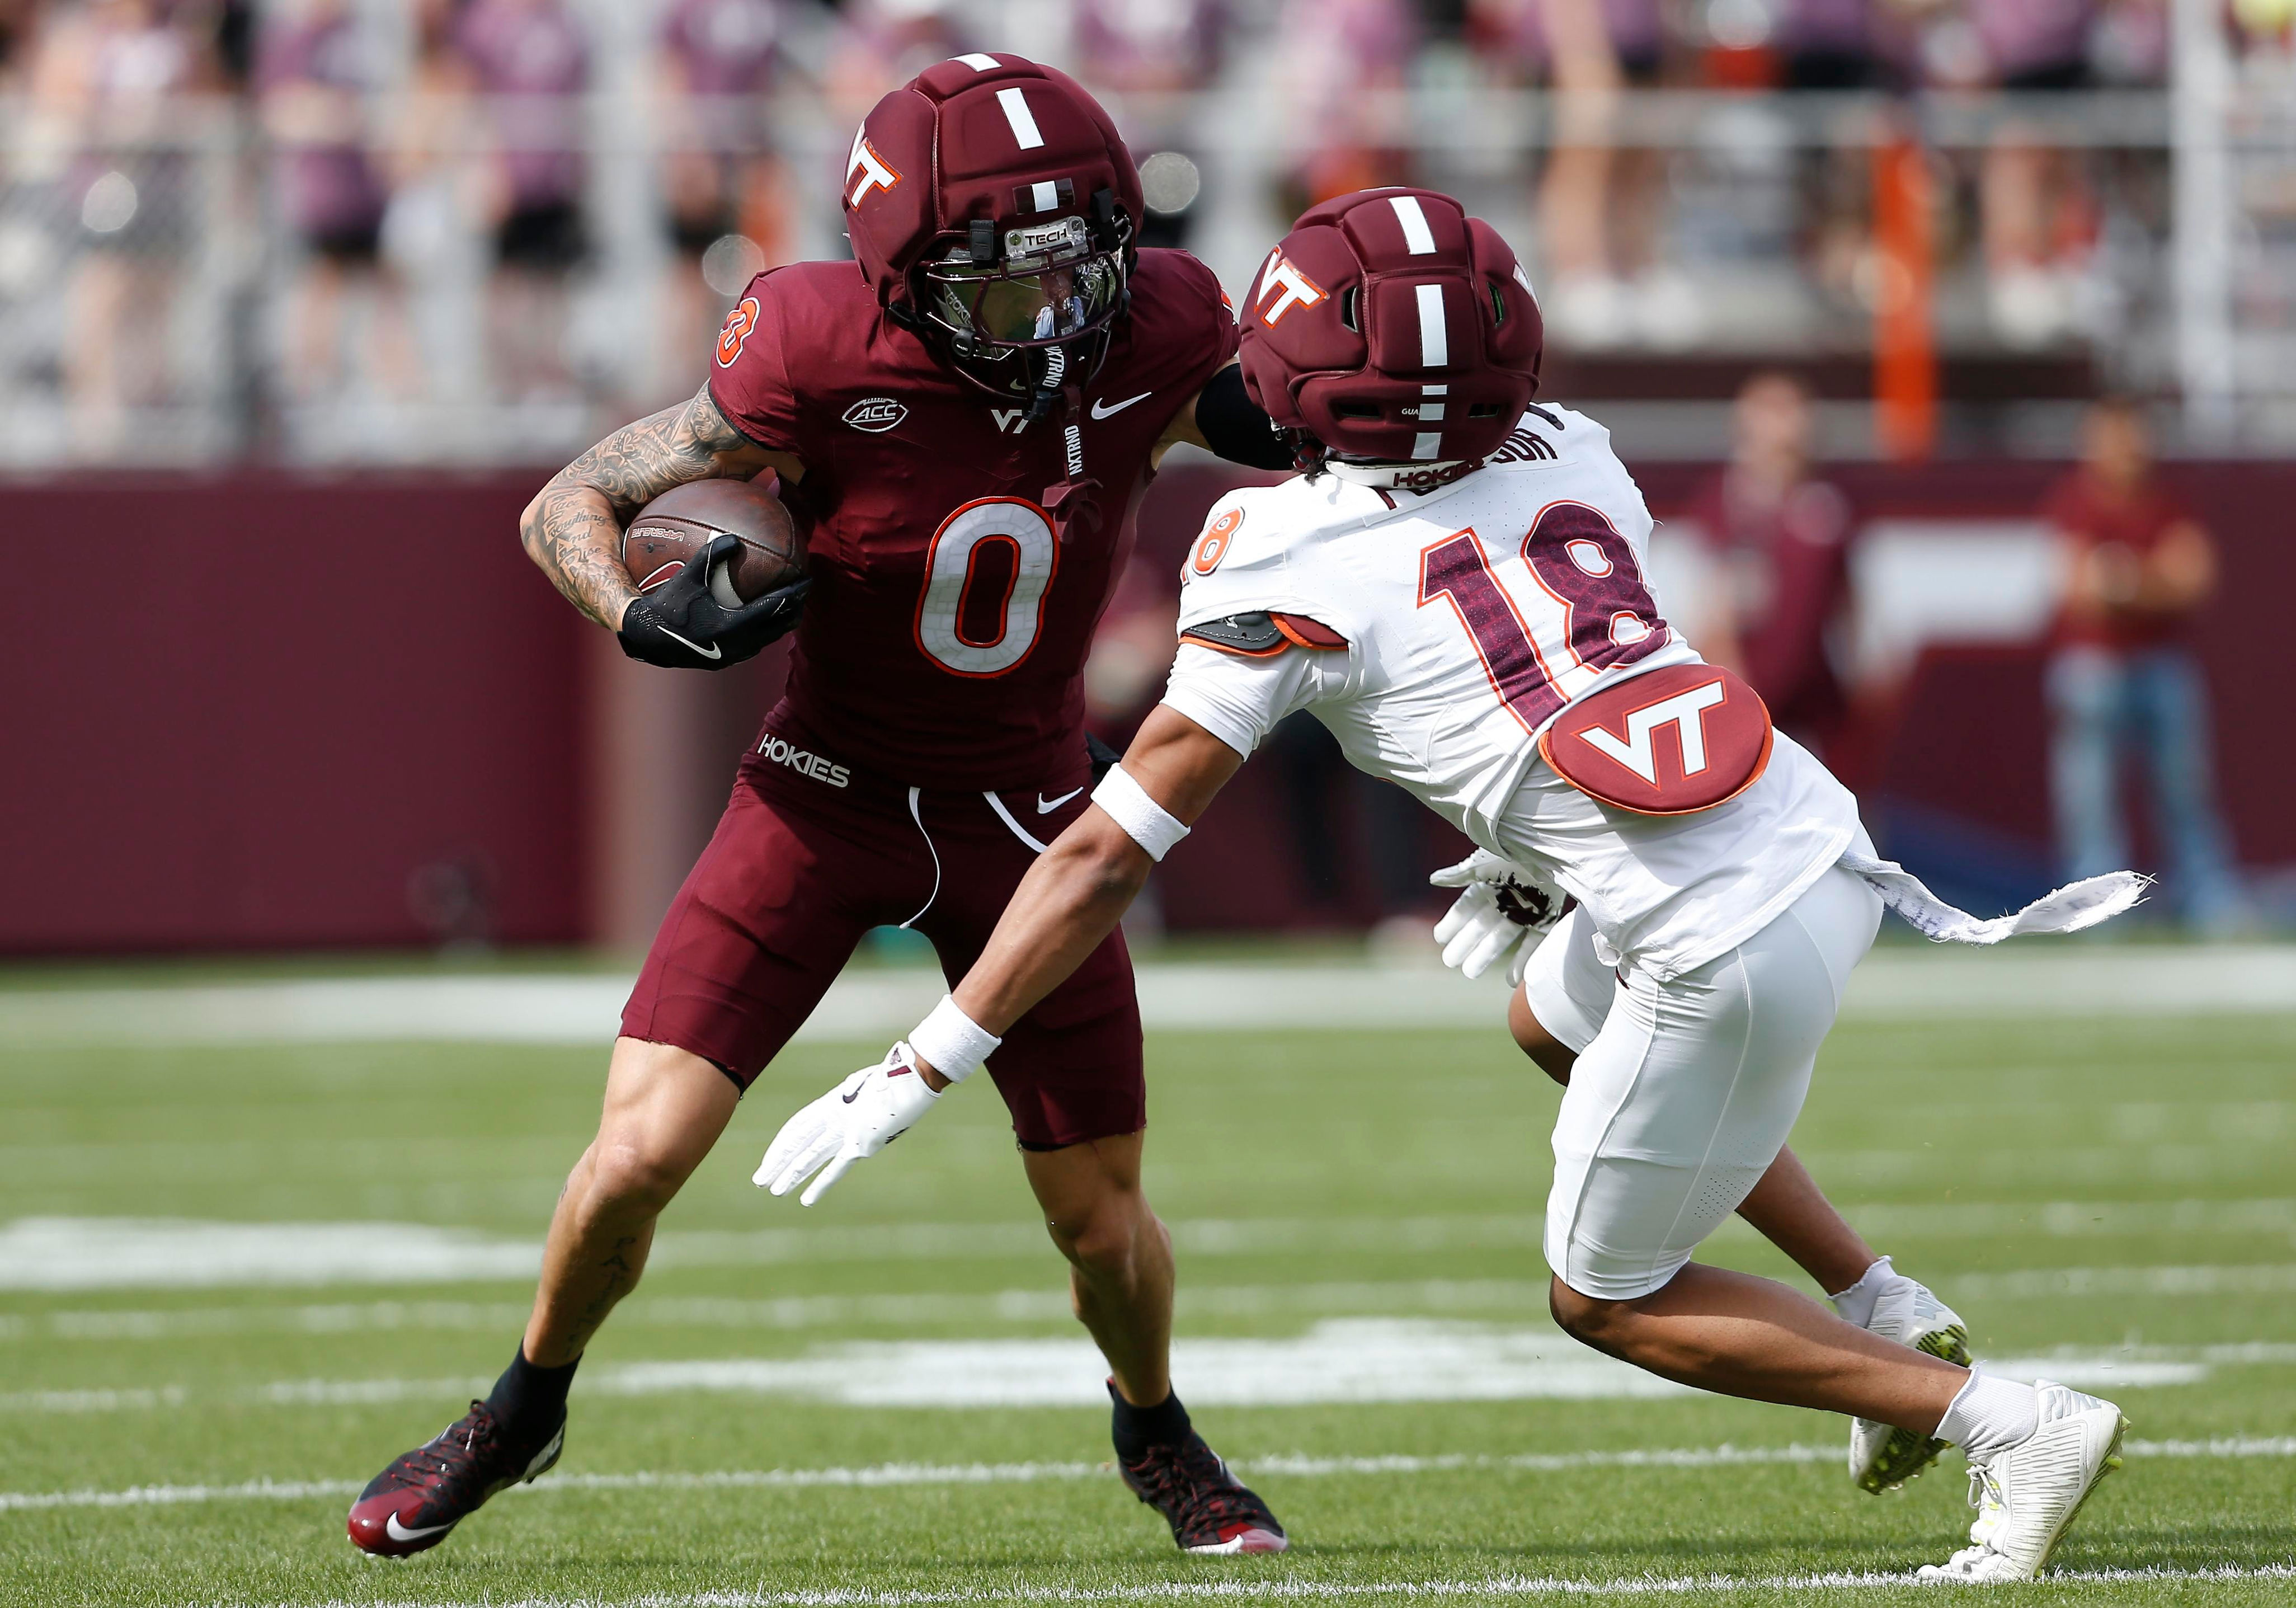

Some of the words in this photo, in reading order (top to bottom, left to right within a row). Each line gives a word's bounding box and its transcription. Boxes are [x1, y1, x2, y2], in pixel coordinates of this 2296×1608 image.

[1024, 227, 1067, 246] TECH
[1254, 244, 1330, 330] VT
[852, 404, 898, 420] ACC
[1065, 425, 1083, 476] NXTRND
[913, 496, 1060, 679] 0
[1417, 499, 1672, 735] 18
[757, 734, 850, 788] HOKIES
[1569, 675, 1726, 791] VT
